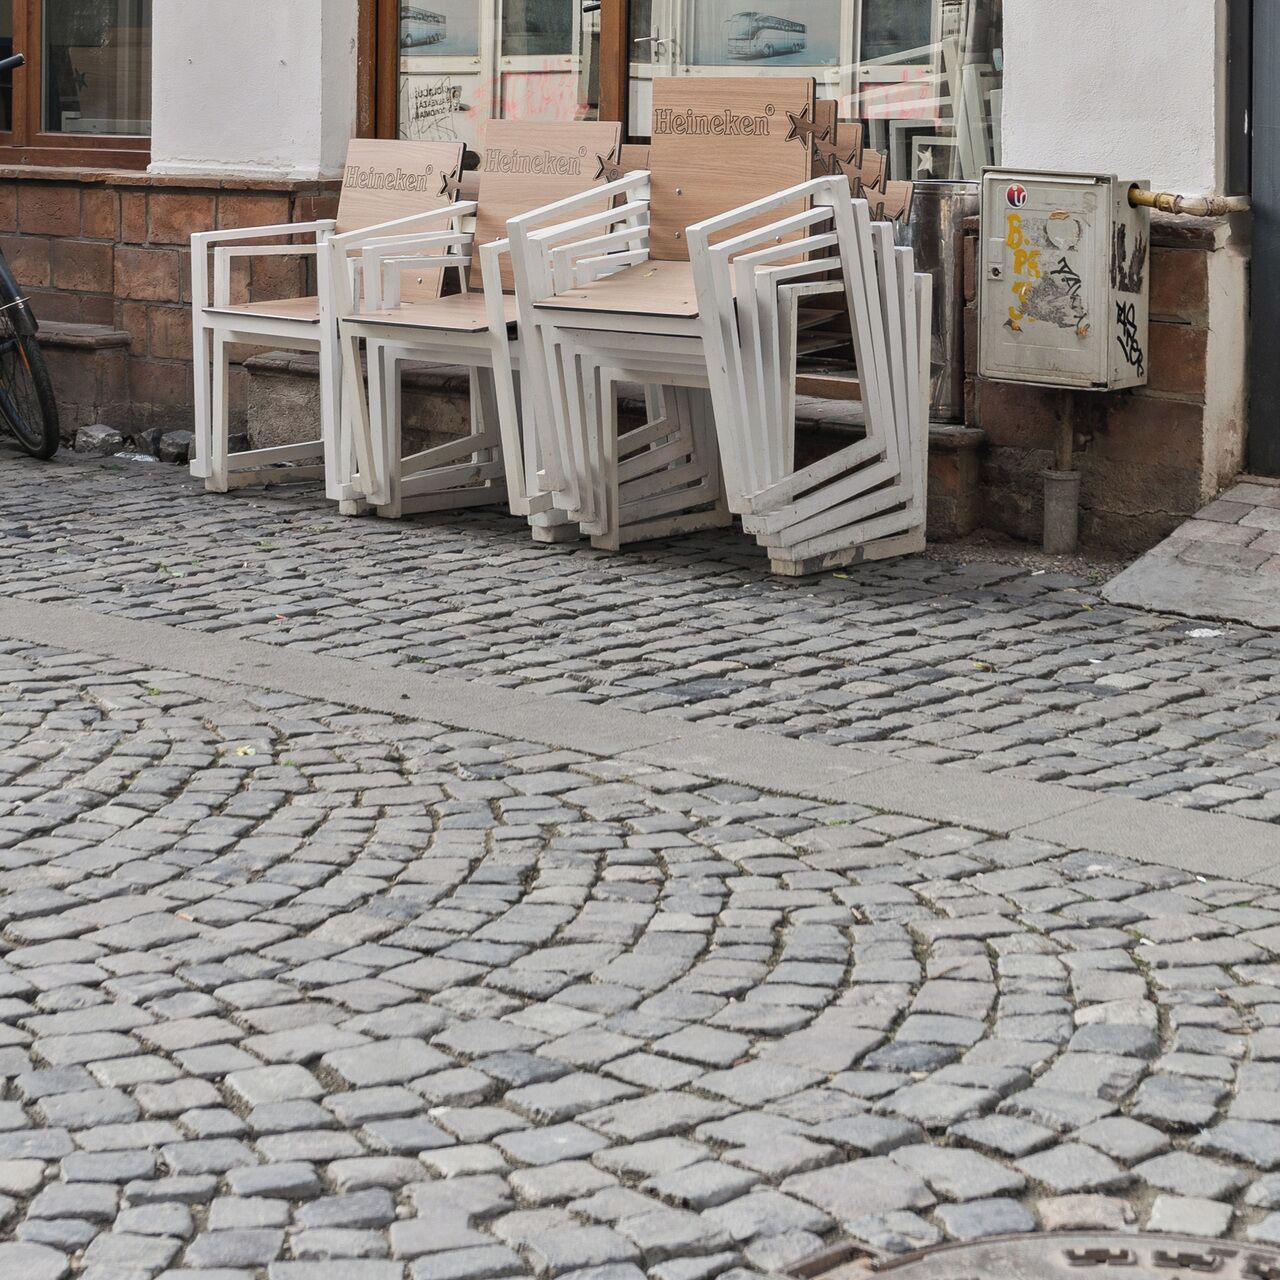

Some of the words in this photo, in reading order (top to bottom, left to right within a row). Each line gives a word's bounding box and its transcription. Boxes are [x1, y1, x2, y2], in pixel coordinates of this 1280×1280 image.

[654, 108, 770, 136] Heineken
[484, 147, 581, 175] Heineken
[344, 165, 428, 192] Heineken
